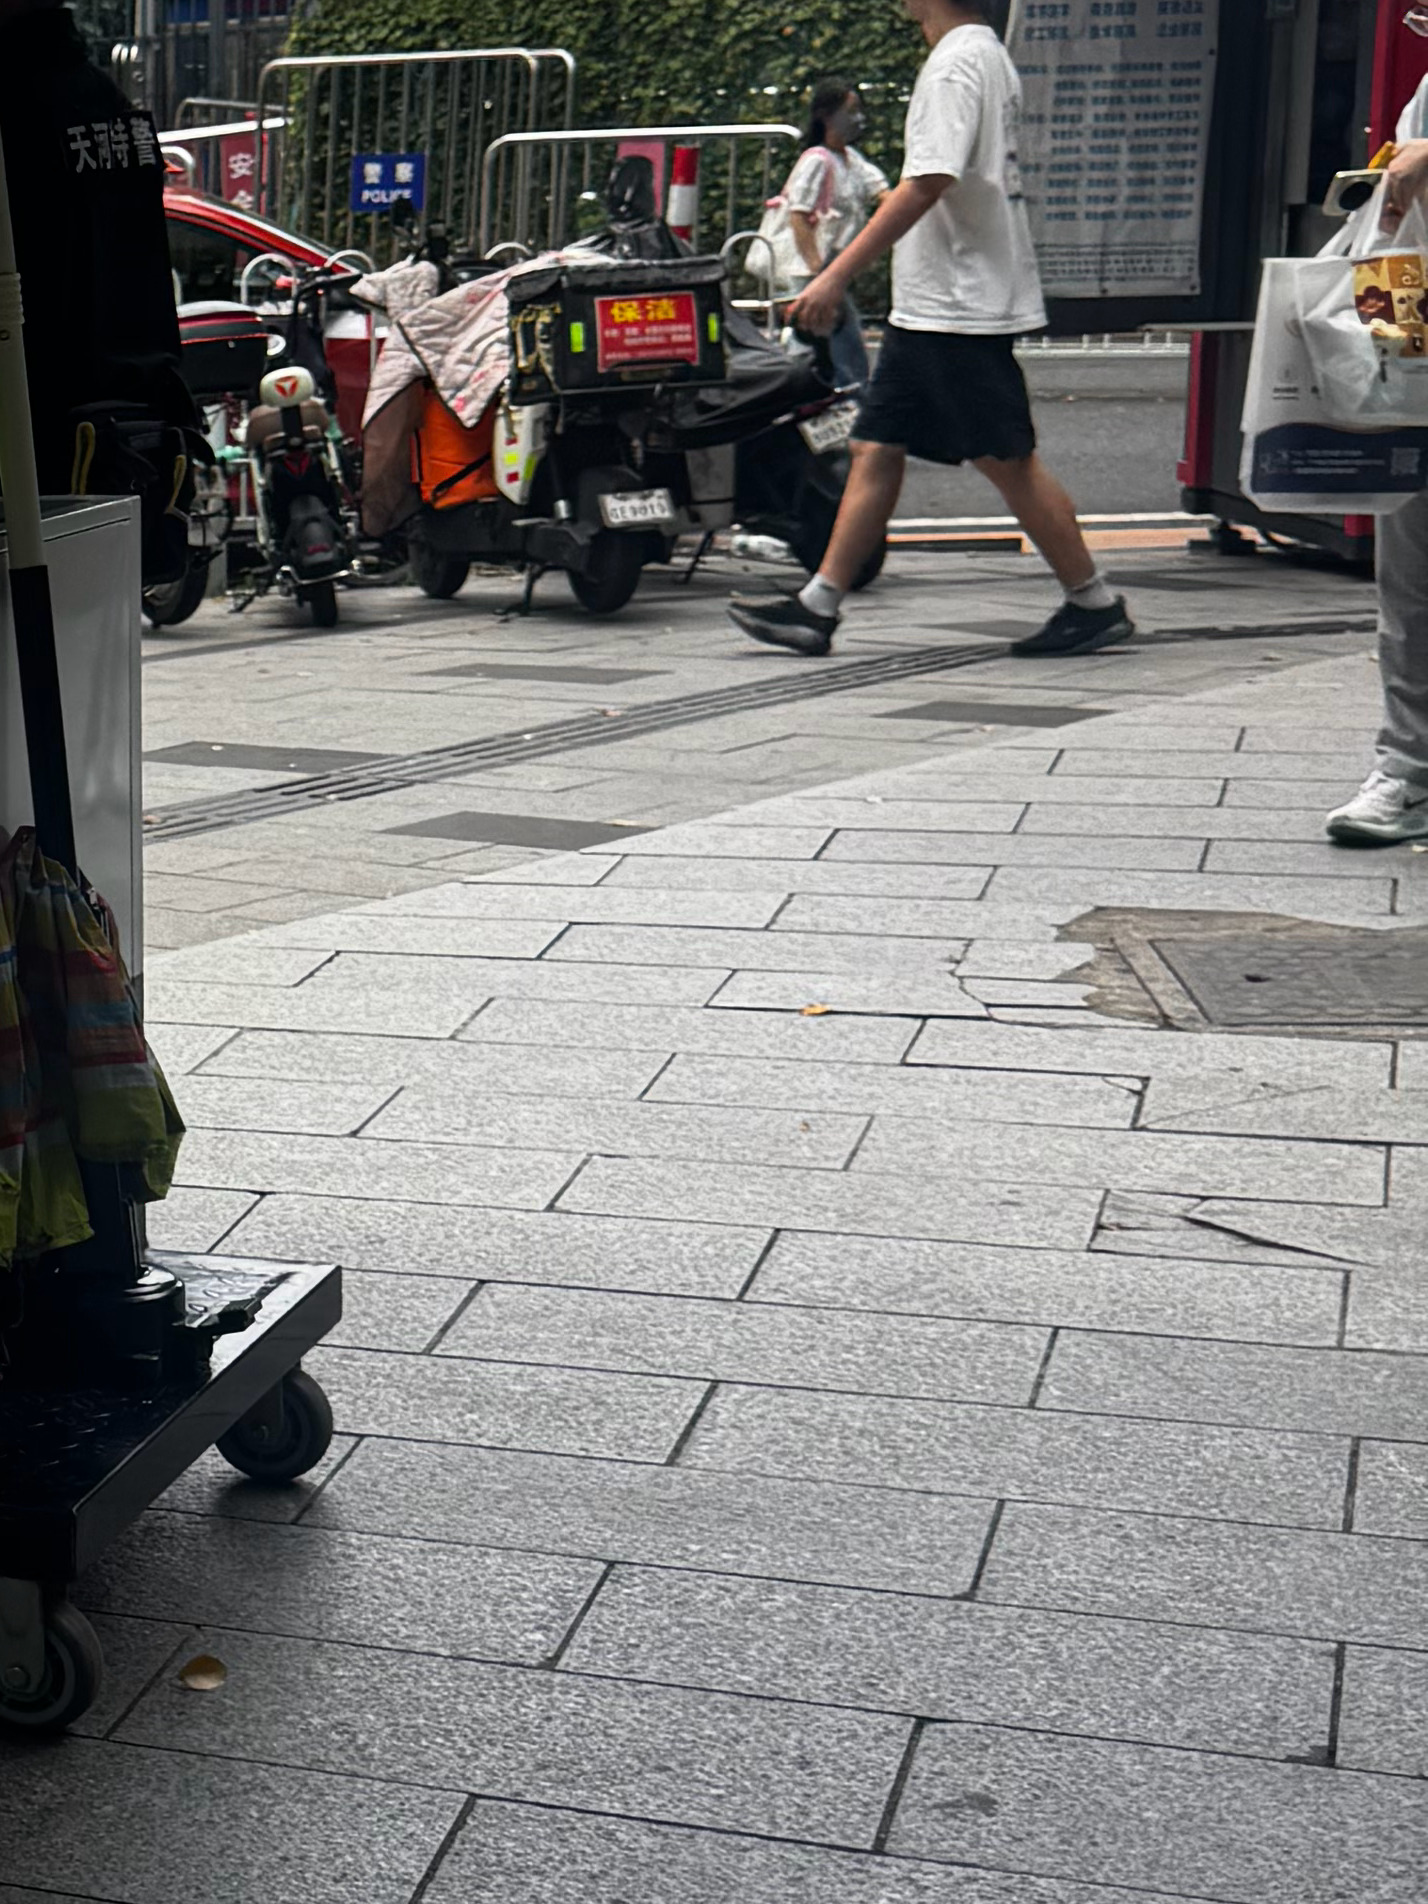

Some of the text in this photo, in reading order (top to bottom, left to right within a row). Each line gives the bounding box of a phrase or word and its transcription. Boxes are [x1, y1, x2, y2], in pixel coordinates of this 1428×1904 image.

[66, 116, 157, 174] 天河特警
[362, 161, 415, 185] 警察
[610, 298, 676, 324] 保洁
